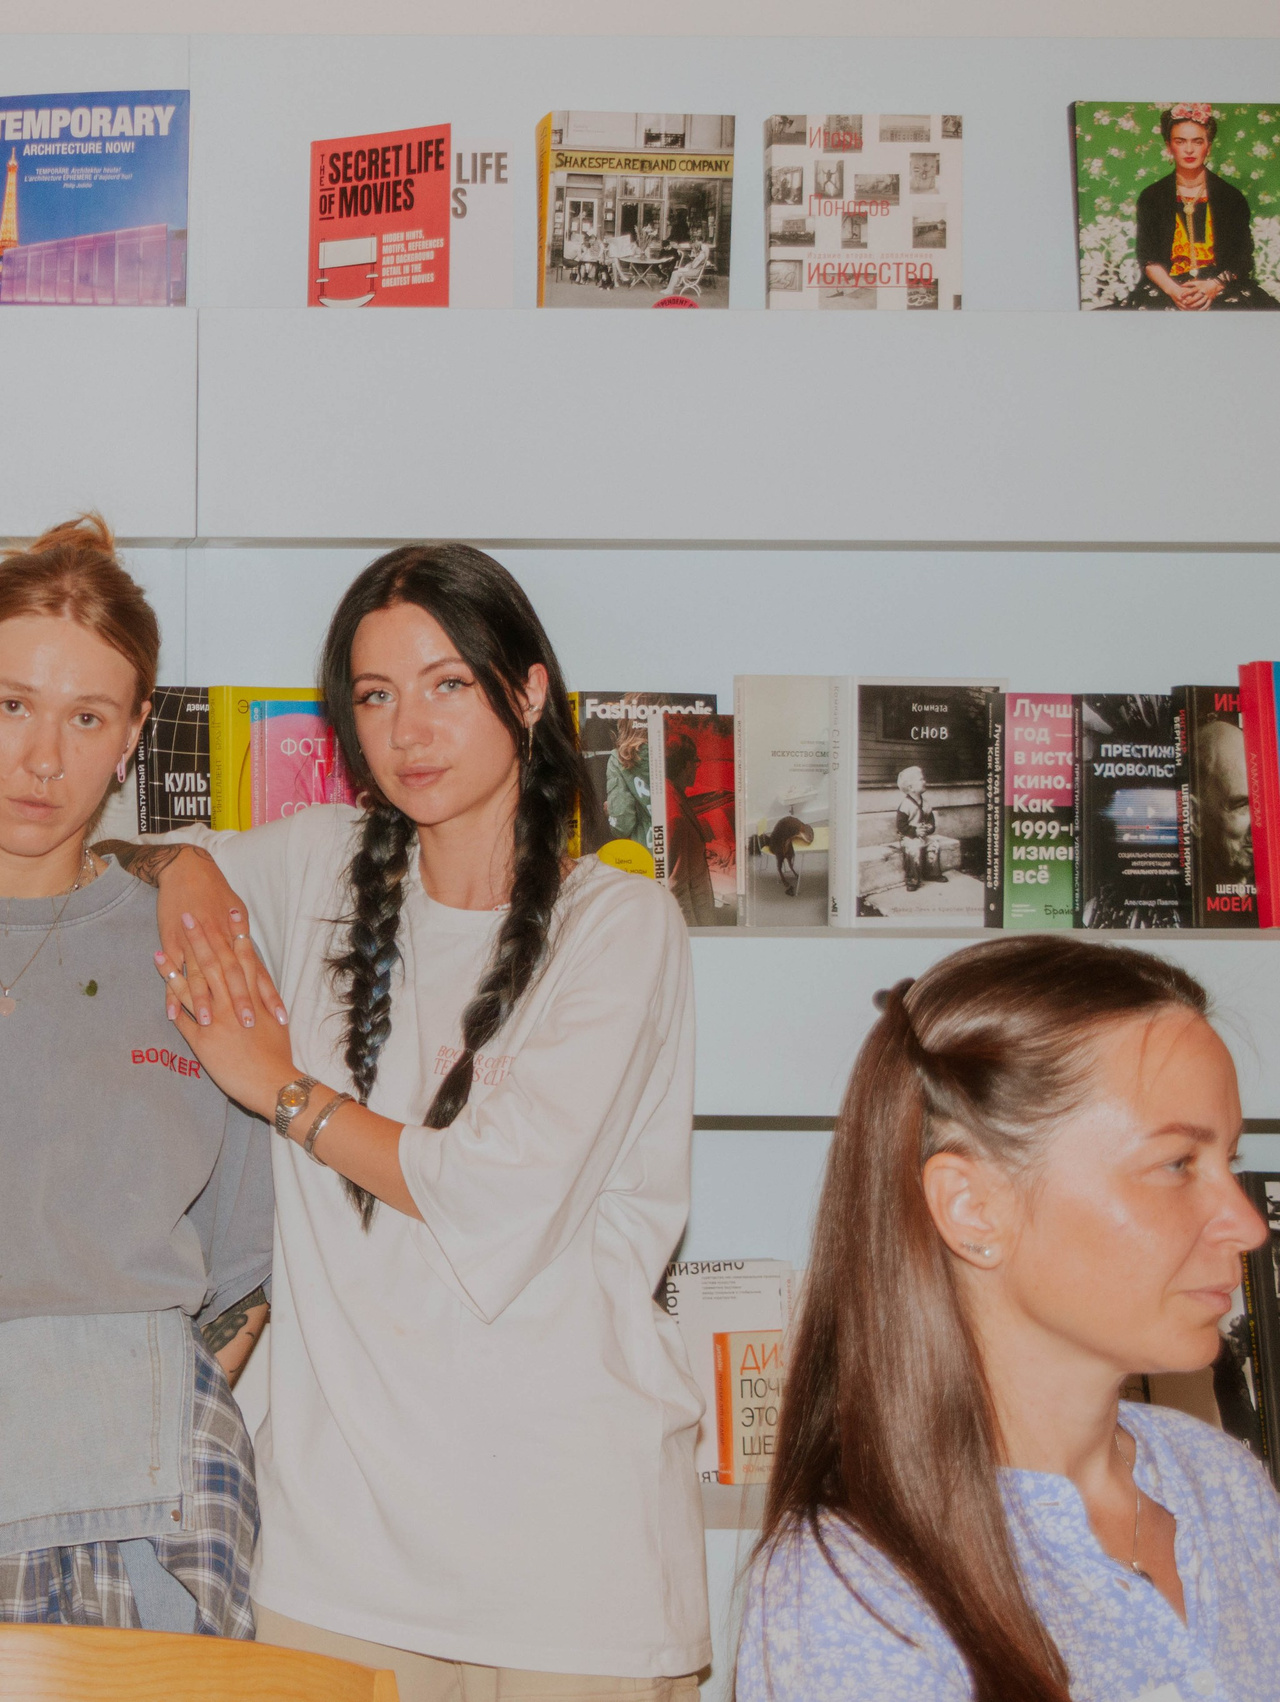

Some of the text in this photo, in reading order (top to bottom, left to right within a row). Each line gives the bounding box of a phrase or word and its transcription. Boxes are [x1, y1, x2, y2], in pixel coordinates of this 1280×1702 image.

[22, 141, 135, 157] ARCHITECTURE NOW!
[809, 127, 863, 152] Игорь
[328, 138, 445, 184] SECRET LIFE
[455, 152, 508, 184] LIFE
[555, 152, 730, 172] SHAKESPEARE AND COMPANY
[319, 178, 415, 219] OF MOVIES
[808, 194, 890, 217] Поносов
[807, 262, 933, 286] ИСКУССТВО
[186, 703, 210, 712] ДЭВИД
[586, 698, 712, 719] Fashionopolis
[911, 703, 948, 713] Комната
[1013, 699, 1072, 720] Лучш
[1214, 694, 1241, 712] ИН
[1014, 727, 1050, 744] год
[1173, 716, 1182, 766] БЕРГМАН
[281, 738, 326, 756] ФОТ
[993, 724, 1001, 772] Лучший
[1100, 743, 1174, 759] ПРЕСТИЖ
[1014, 753, 1025, 765] в
[1093, 763, 1175, 780] УДОВОЛЬС
[165, 773, 210, 792] КУЛЬ
[138, 764, 148, 832] КУЛЬТУРНЫЙ
[174, 797, 211, 816] ИНТ
[1013, 795, 1054, 813] Как
[1181, 784, 1190, 833] ШЕПОТЫ
[992, 806, 1000, 854] истории
[1011, 821, 1072, 839] 1999-
[654, 825, 665, 879] ВНЕ СЕБЯ
[1013, 846, 1073, 860] изме
[1013, 865, 1049, 884] всё
[1183, 848, 1191, 886] КРИКИ
[1207, 895, 1252, 912] МОЕЙ
[131, 1047, 201, 1079] BOOKER
[740, 1343, 783, 1376] ДИ
[741, 1408, 778, 1428] ЭТО
[742, 1436, 775, 1456] ШЕ
